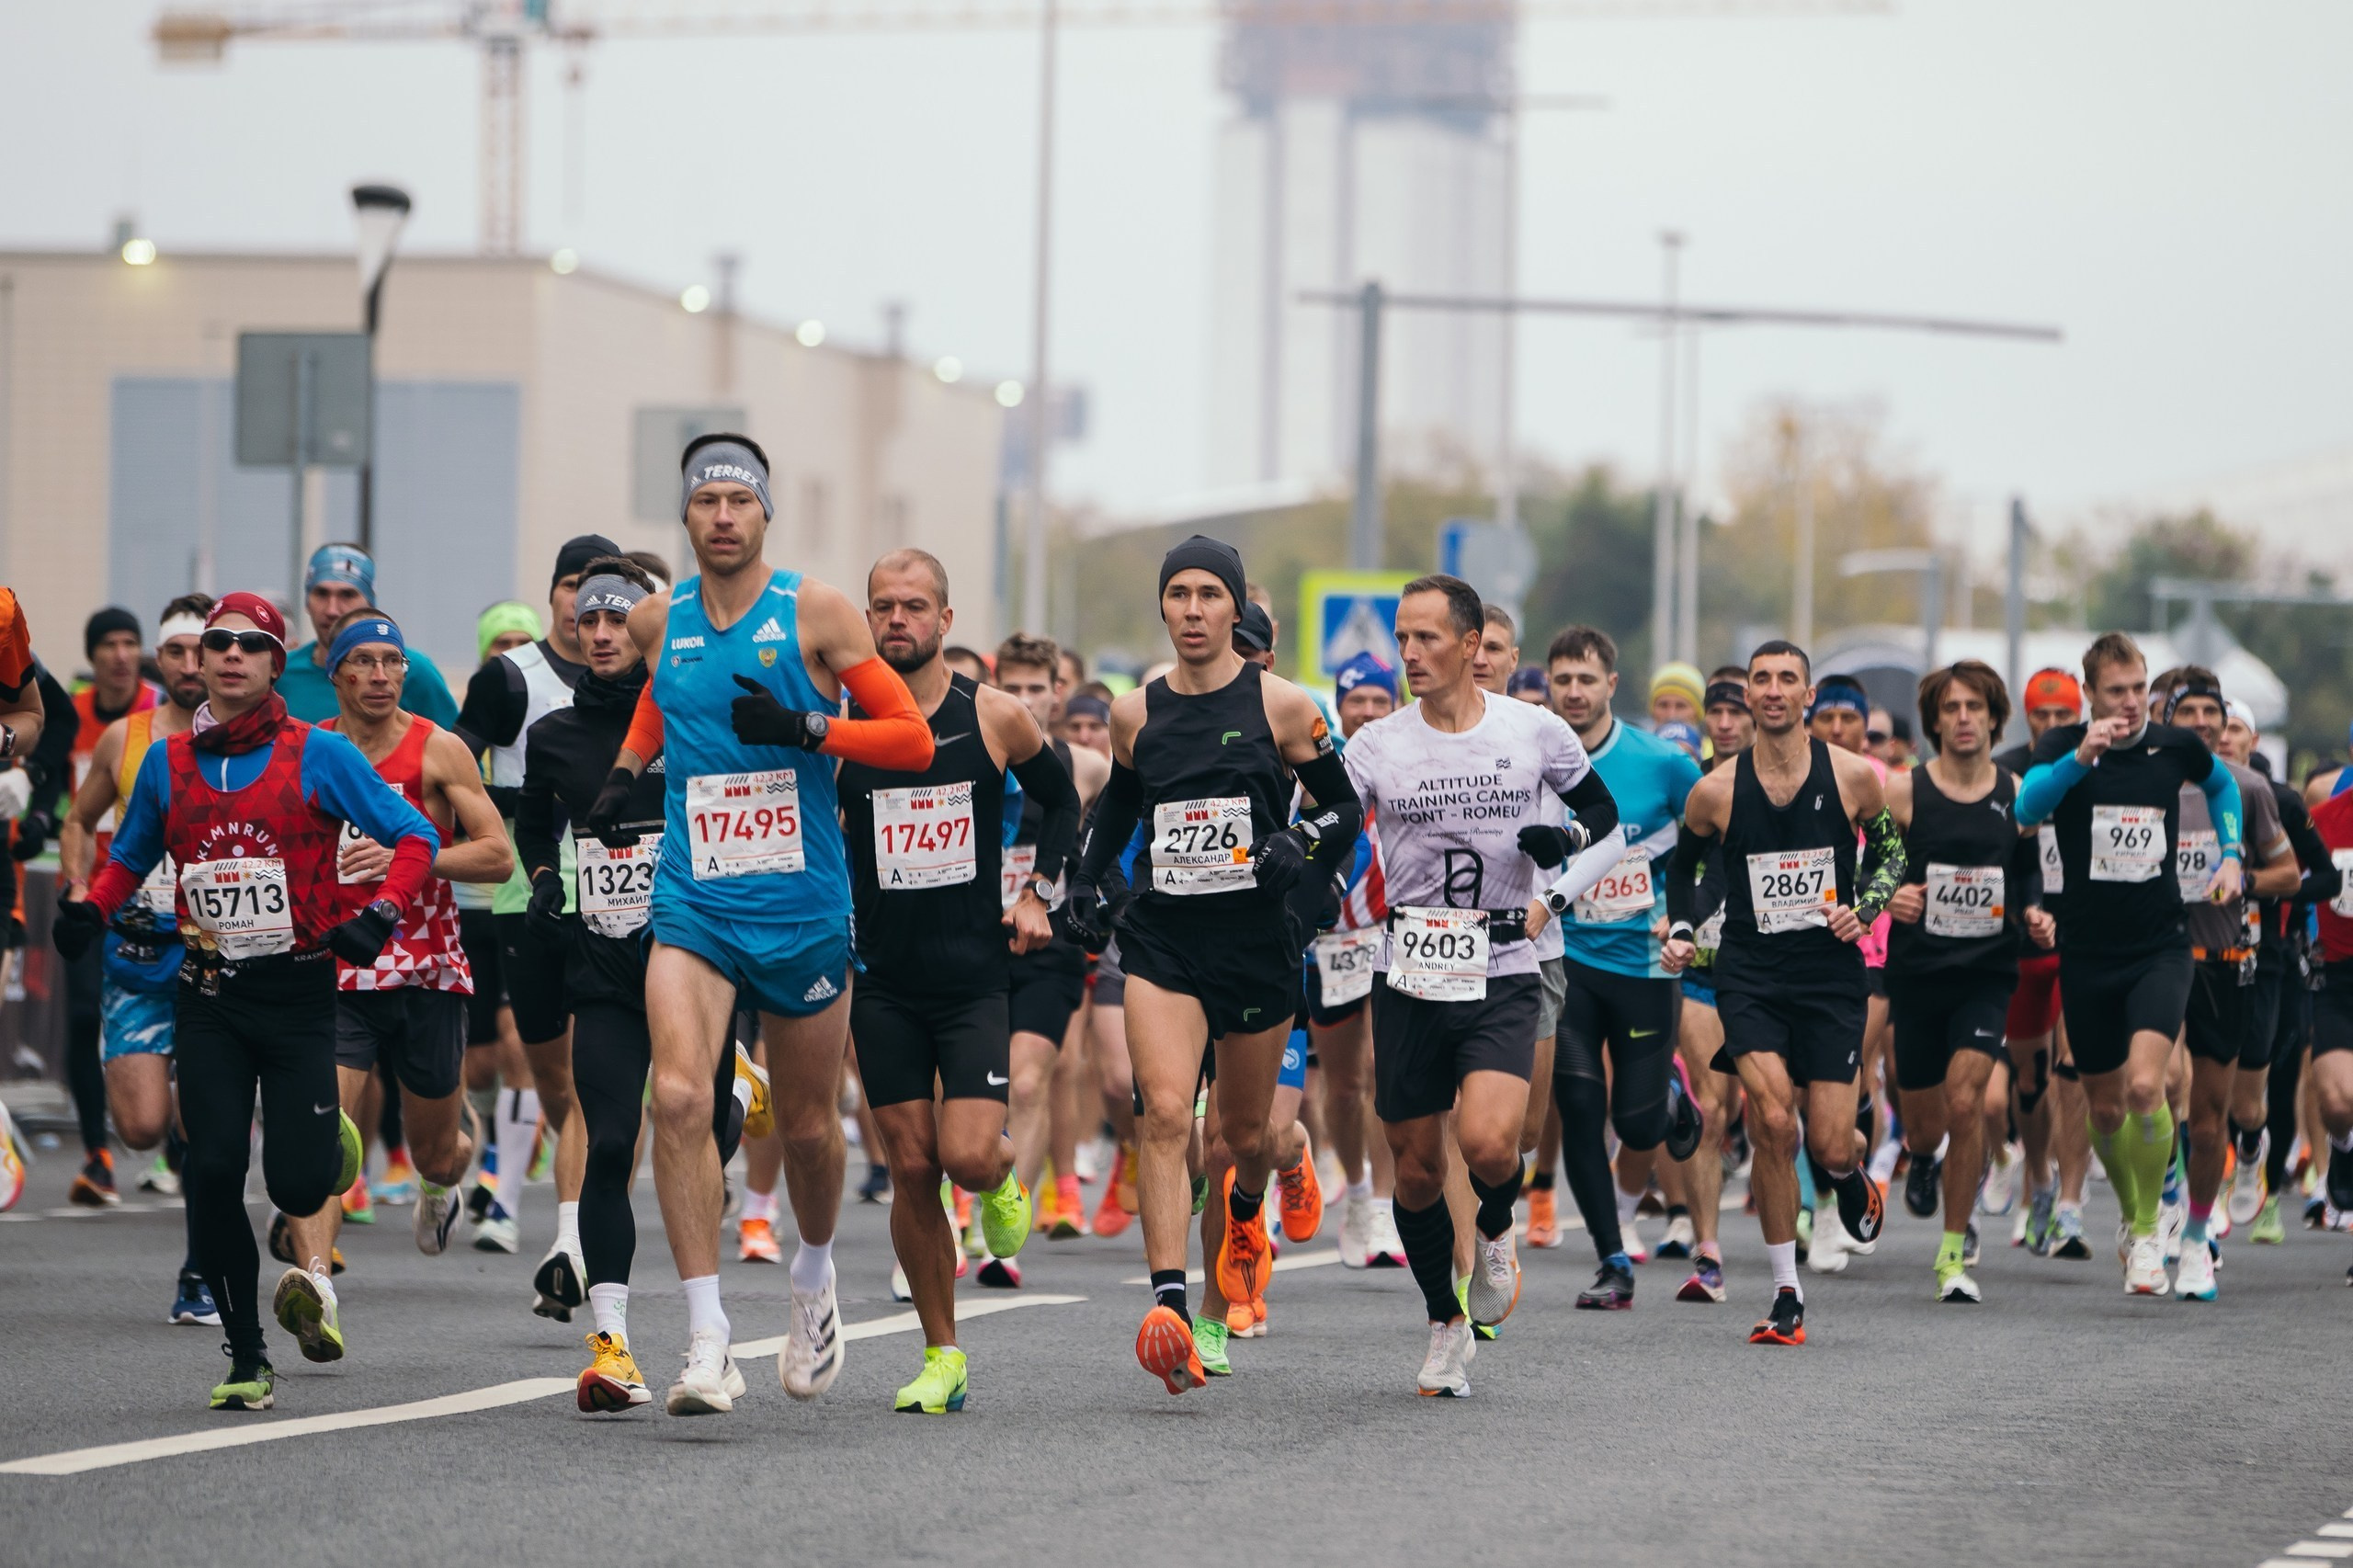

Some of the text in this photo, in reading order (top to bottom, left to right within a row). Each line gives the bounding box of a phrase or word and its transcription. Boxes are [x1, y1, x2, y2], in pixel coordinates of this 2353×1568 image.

[704, 464, 759, 488] TERREX
[671, 636, 705, 650] LUKOIL
[1418, 774, 1503, 791] ALTITUDE
[1388, 789, 1531, 812] TRAINING CAMPS
[694, 805, 797, 843] 17495
[1400, 809, 1446, 824] FONT
[1463, 805, 1520, 821] ROMEU
[197, 822, 278, 861] KLMNRUN
[881, 817, 970, 854] 17497
[1164, 822, 1238, 854] 2726
[2110, 827, 2152, 848] 969
[707, 856, 719, 872] A
[1174, 853, 1231, 865] АЛЕКСАНДР
[1254, 846, 1272, 872] MOAX
[891, 868, 903, 884] A
[1165, 869, 1176, 885] A
[1761, 869, 1824, 899] 2867
[190, 883, 285, 918] 15713
[608, 895, 650, 907] МИХАИЛ
[1771, 897, 1818, 908] ВЛАДИМИР
[1935, 885, 1994, 908] 4402
[219, 920, 255, 930] РОМАН
[592, 914, 603, 929] A
[1762, 913, 1772, 926] A
[1403, 931, 1475, 960] 9603
[1394, 974, 1407, 988] A
